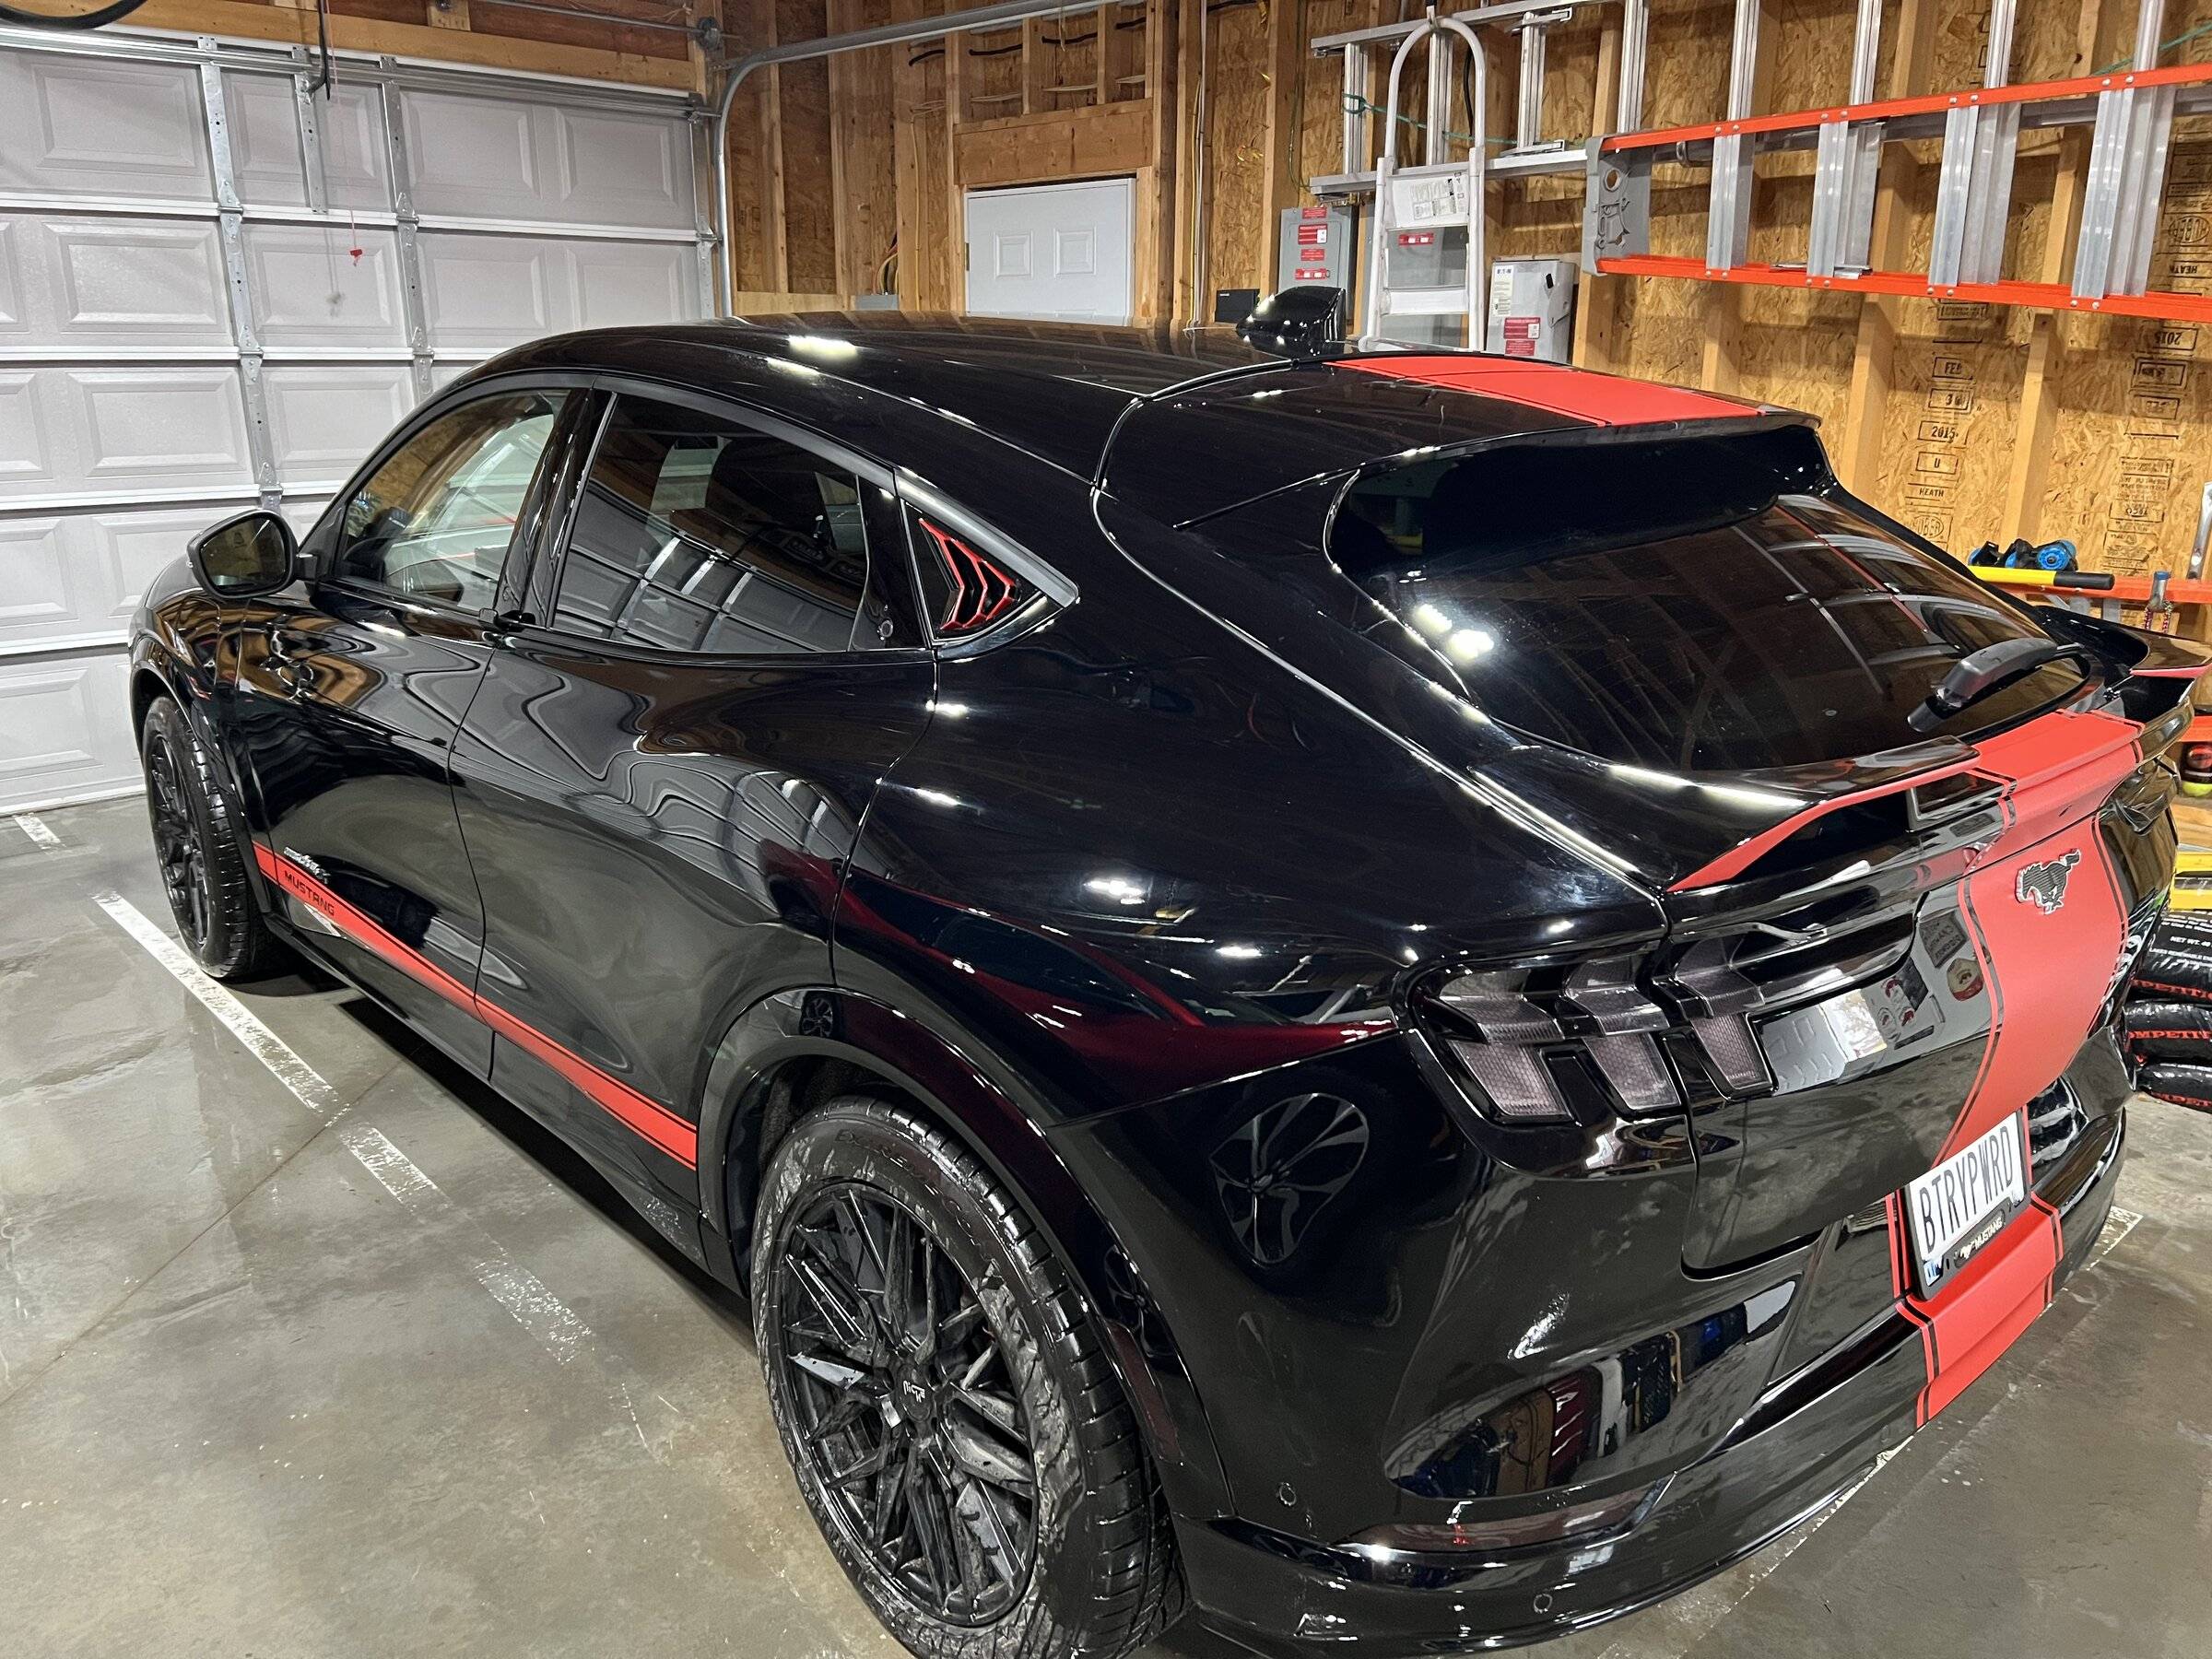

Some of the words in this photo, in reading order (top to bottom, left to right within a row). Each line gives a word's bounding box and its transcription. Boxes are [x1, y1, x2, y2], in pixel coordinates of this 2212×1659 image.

[1931, 425, 1956, 440] 2015
[1934, 457, 1941, 469] U
[1919, 488, 1945, 497] HEATH
[284, 870, 335, 916] MUSTANG
[1920, 1126, 2013, 1253] BTRYPWRD
